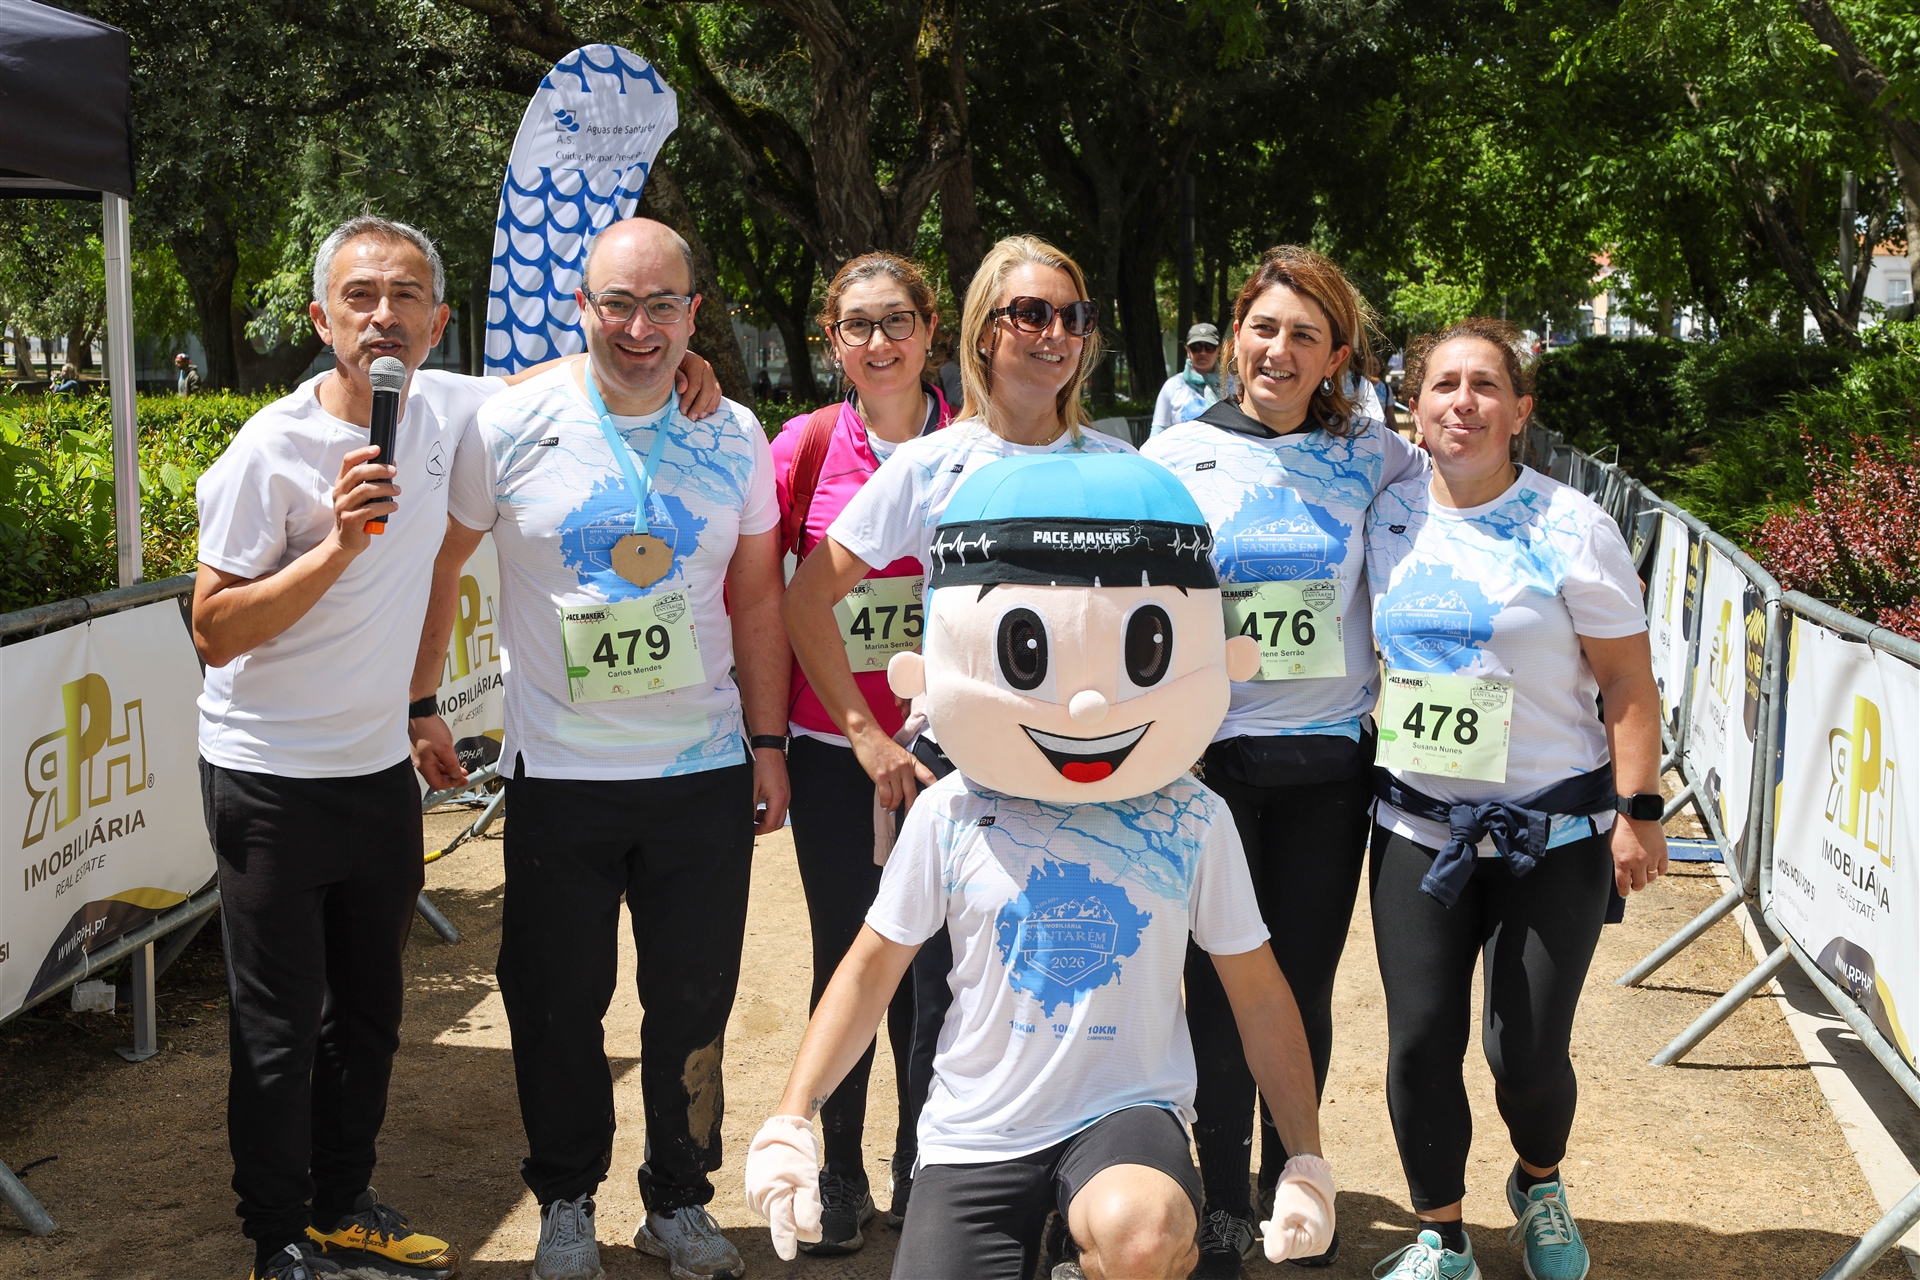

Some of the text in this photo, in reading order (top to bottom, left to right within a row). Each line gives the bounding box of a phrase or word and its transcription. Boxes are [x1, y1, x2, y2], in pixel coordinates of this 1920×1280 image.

[586, 123, 611, 135] Águas
[612, 124, 623, 134] de
[556, 135, 575, 145] A.S.
[1241, 540, 1318, 553] SANTARÉM
[1266, 565, 1298, 576] 2026
[850, 603, 925, 642] 475
[1239, 609, 1316, 647] 476
[1390, 617, 1462, 630] SANTARÉM
[592, 624, 671, 669] 479
[864, 641, 914, 651] Marina Serrão
[1280, 649, 1305, 657] Serrão
[1414, 640, 1446, 652] 2026
[607, 664, 663, 679] Carlos Mendes
[436, 672, 505, 717] MOBILIÁRIA
[1402, 702, 1479, 746] 478
[1412, 742, 1463, 755] Susana Nunes
[24, 809, 146, 892] IMOBILIÁRIA
[55, 854, 107, 899] REAL ESTATE
[1024, 928, 1107, 943] SANTARÉM
[1051, 956, 1086, 969] 2026
[1008, 1020, 1036, 1033] 18KM
[1087, 1025, 1117, 1035] 10KM
